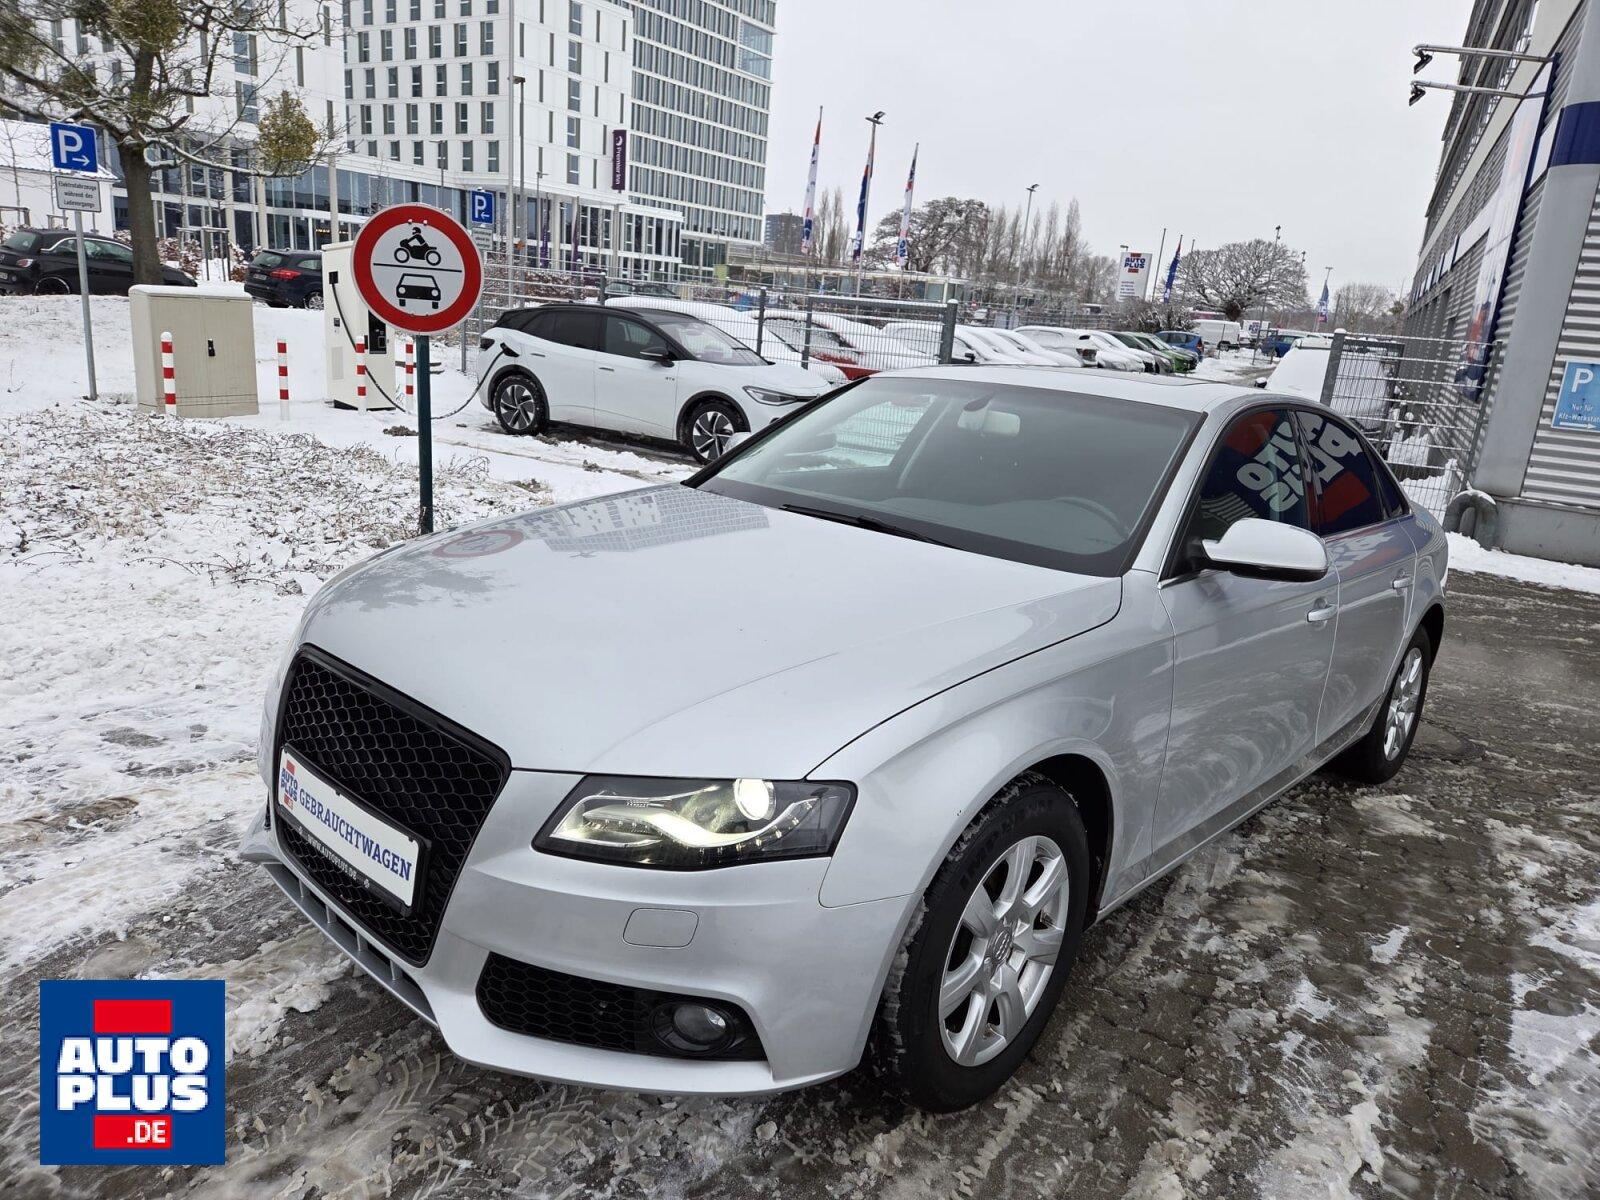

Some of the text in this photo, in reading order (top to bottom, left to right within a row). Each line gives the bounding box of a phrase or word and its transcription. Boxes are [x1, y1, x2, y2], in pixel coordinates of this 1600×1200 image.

[58, 129, 83, 164] P
[58, 180, 97, 191] Elektrofahrzeuge
[64, 190, 84, 198] während
[474, 194, 487, 219] P
[1571, 367, 1594, 393] P
[1571, 403, 1594, 413] Nur für
[280, 778, 298, 802] PLUS
[281, 767, 298, 790] AUTO
[300, 788, 413, 881] GEBRAUCHTWAGEN
